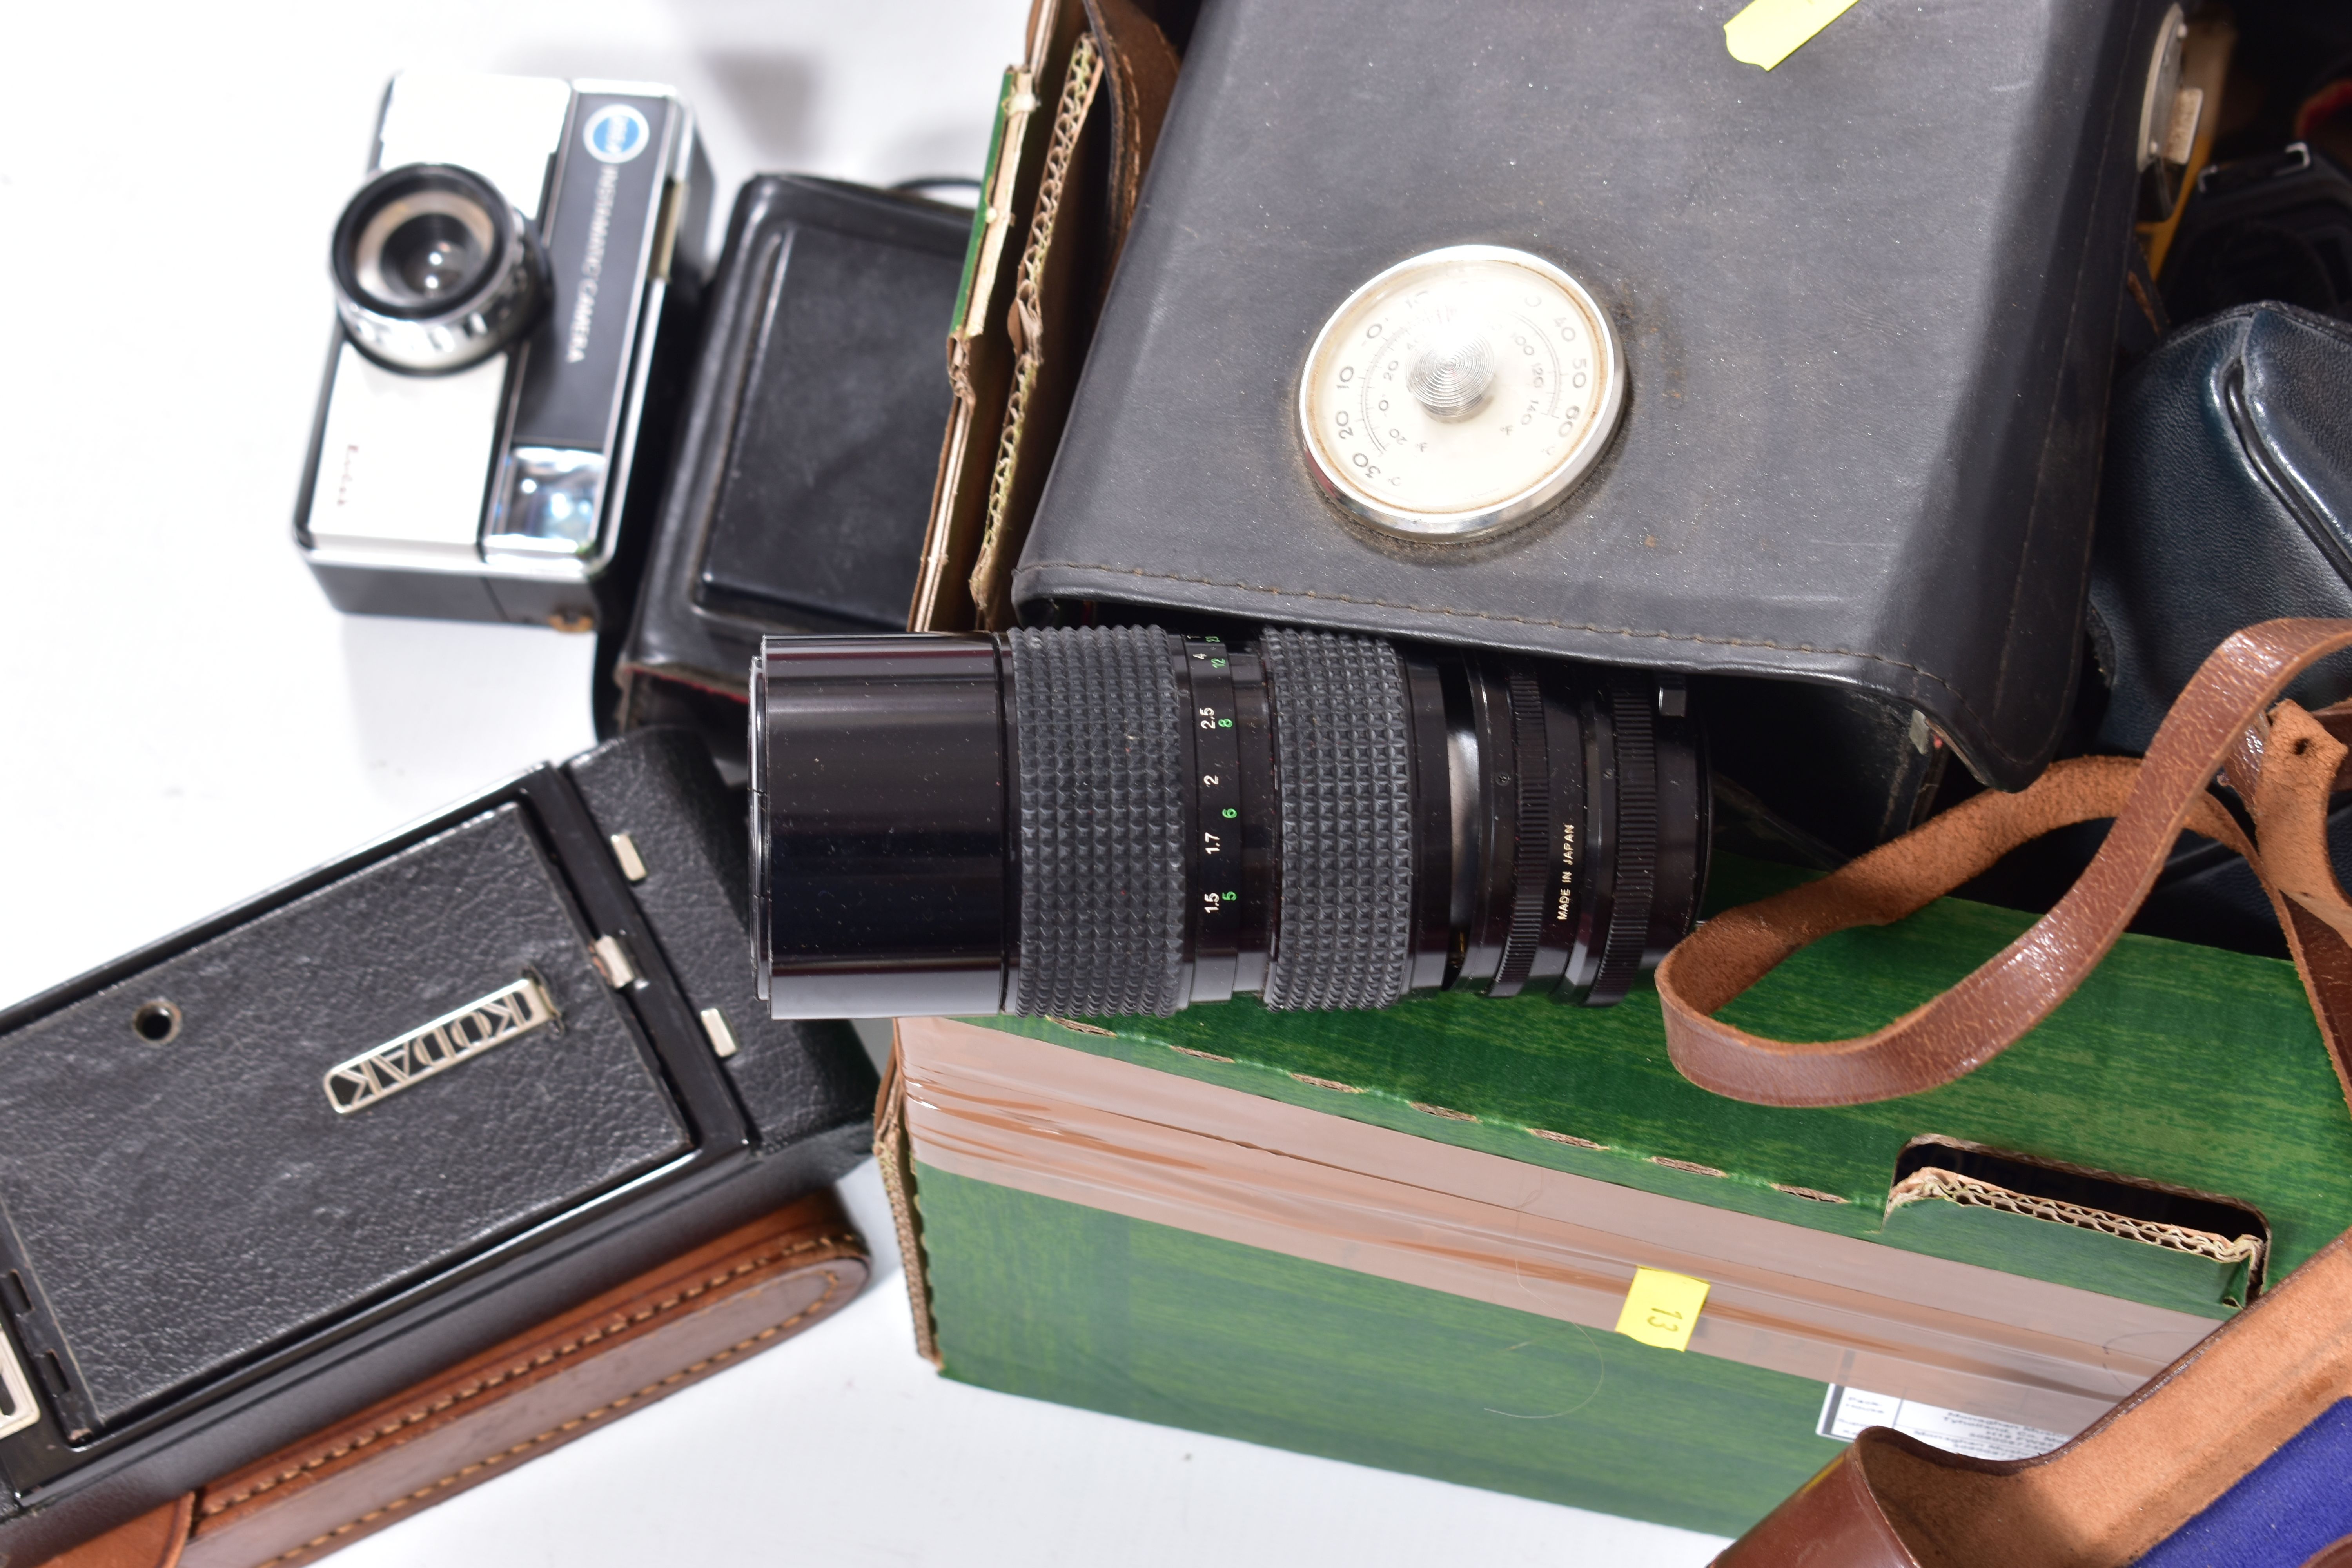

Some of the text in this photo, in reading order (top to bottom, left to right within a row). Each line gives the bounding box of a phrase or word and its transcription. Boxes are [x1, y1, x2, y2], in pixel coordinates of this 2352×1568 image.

[566, 278, 598, 363] CAMERA
[1553, 316, 1575, 342] 40
[1336, 366, 1354, 390] 10
[1383, 360, 1399, 381] 20
[1572, 358, 1587, 389] 50
[1336, 410, 1354, 440] 20
[1559, 405, 1580, 438] 60
[1353, 453, 1381, 479] 30
[1211, 658, 1226, 669] 12
[1200, 707, 1215, 729] 2.5
[1218, 718, 1233, 728] 8
[1204, 775, 1219, 785] 2
[1222, 808, 1237, 818] 6
[1205, 832, 1220, 855] 1.7
[1557, 824, 1575, 920] MADE IN JAPAN
[1204, 893, 1220, 913] 1.5
[1222, 891, 1237, 901] 5
[334, 990, 528, 1105] KODAK
[1647, 1307, 1683, 1332] 13
